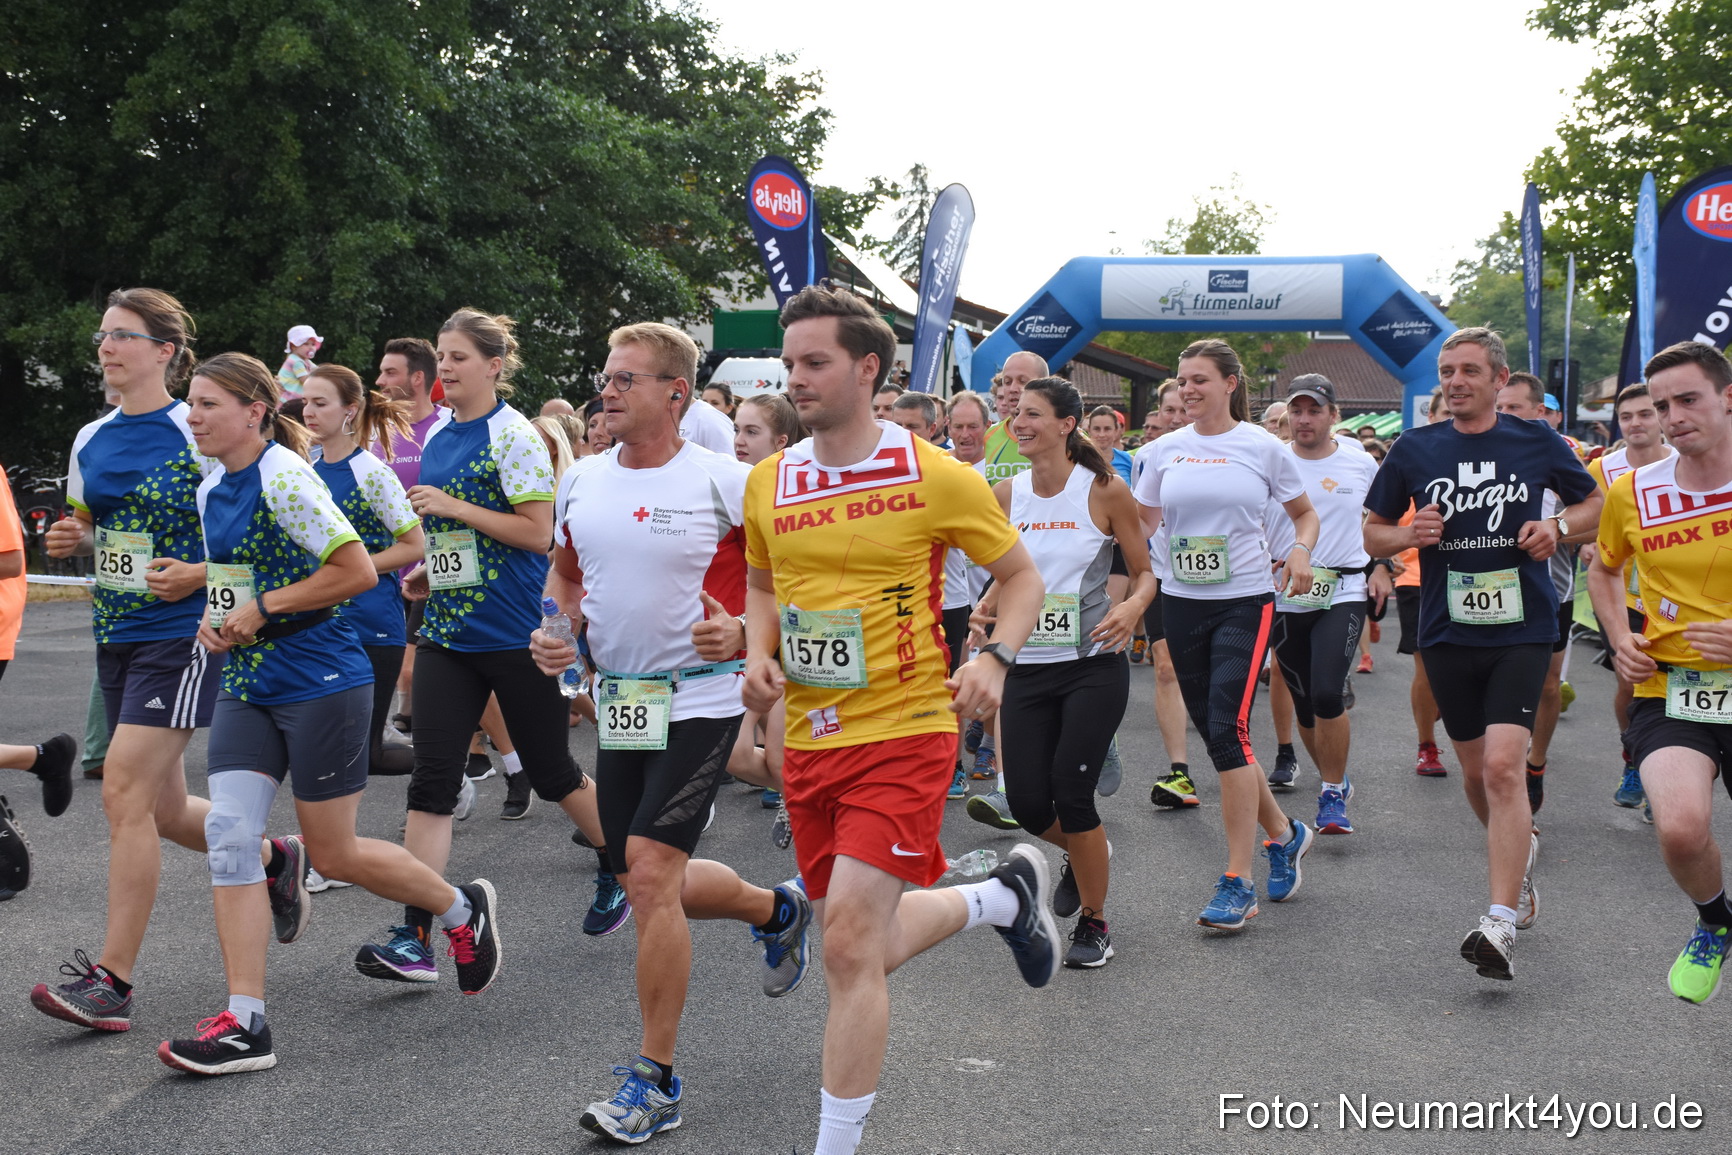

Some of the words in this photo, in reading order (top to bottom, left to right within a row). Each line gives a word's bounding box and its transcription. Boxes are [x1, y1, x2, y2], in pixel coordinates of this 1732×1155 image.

[1193, 294, 1282, 310] firmenlauf
[1024, 322, 1072, 334] Fischer
[654, 507, 693, 515] Bayerisches
[1425, 474, 1528, 532] Burgis
[774, 507, 836, 536] MAX
[846, 492, 926, 520] BÖGL
[650, 526, 687, 536] Norbert
[1032, 522, 1080, 530] KLEBL
[1642, 526, 1704, 553] MAX
[1712, 519, 1732, 536] B
[100, 550, 133, 575] 258
[431, 552, 462, 574] 203
[1176, 553, 1220, 570] 1183
[209, 587, 235, 610] 49
[1312, 582, 1330, 598] 39
[1463, 590, 1502, 610] 401
[786, 635, 850, 667] 1578
[1679, 689, 1732, 710] 167
[608, 705, 648, 730] 358
[1679, 707, 1715, 715] Schönherr
